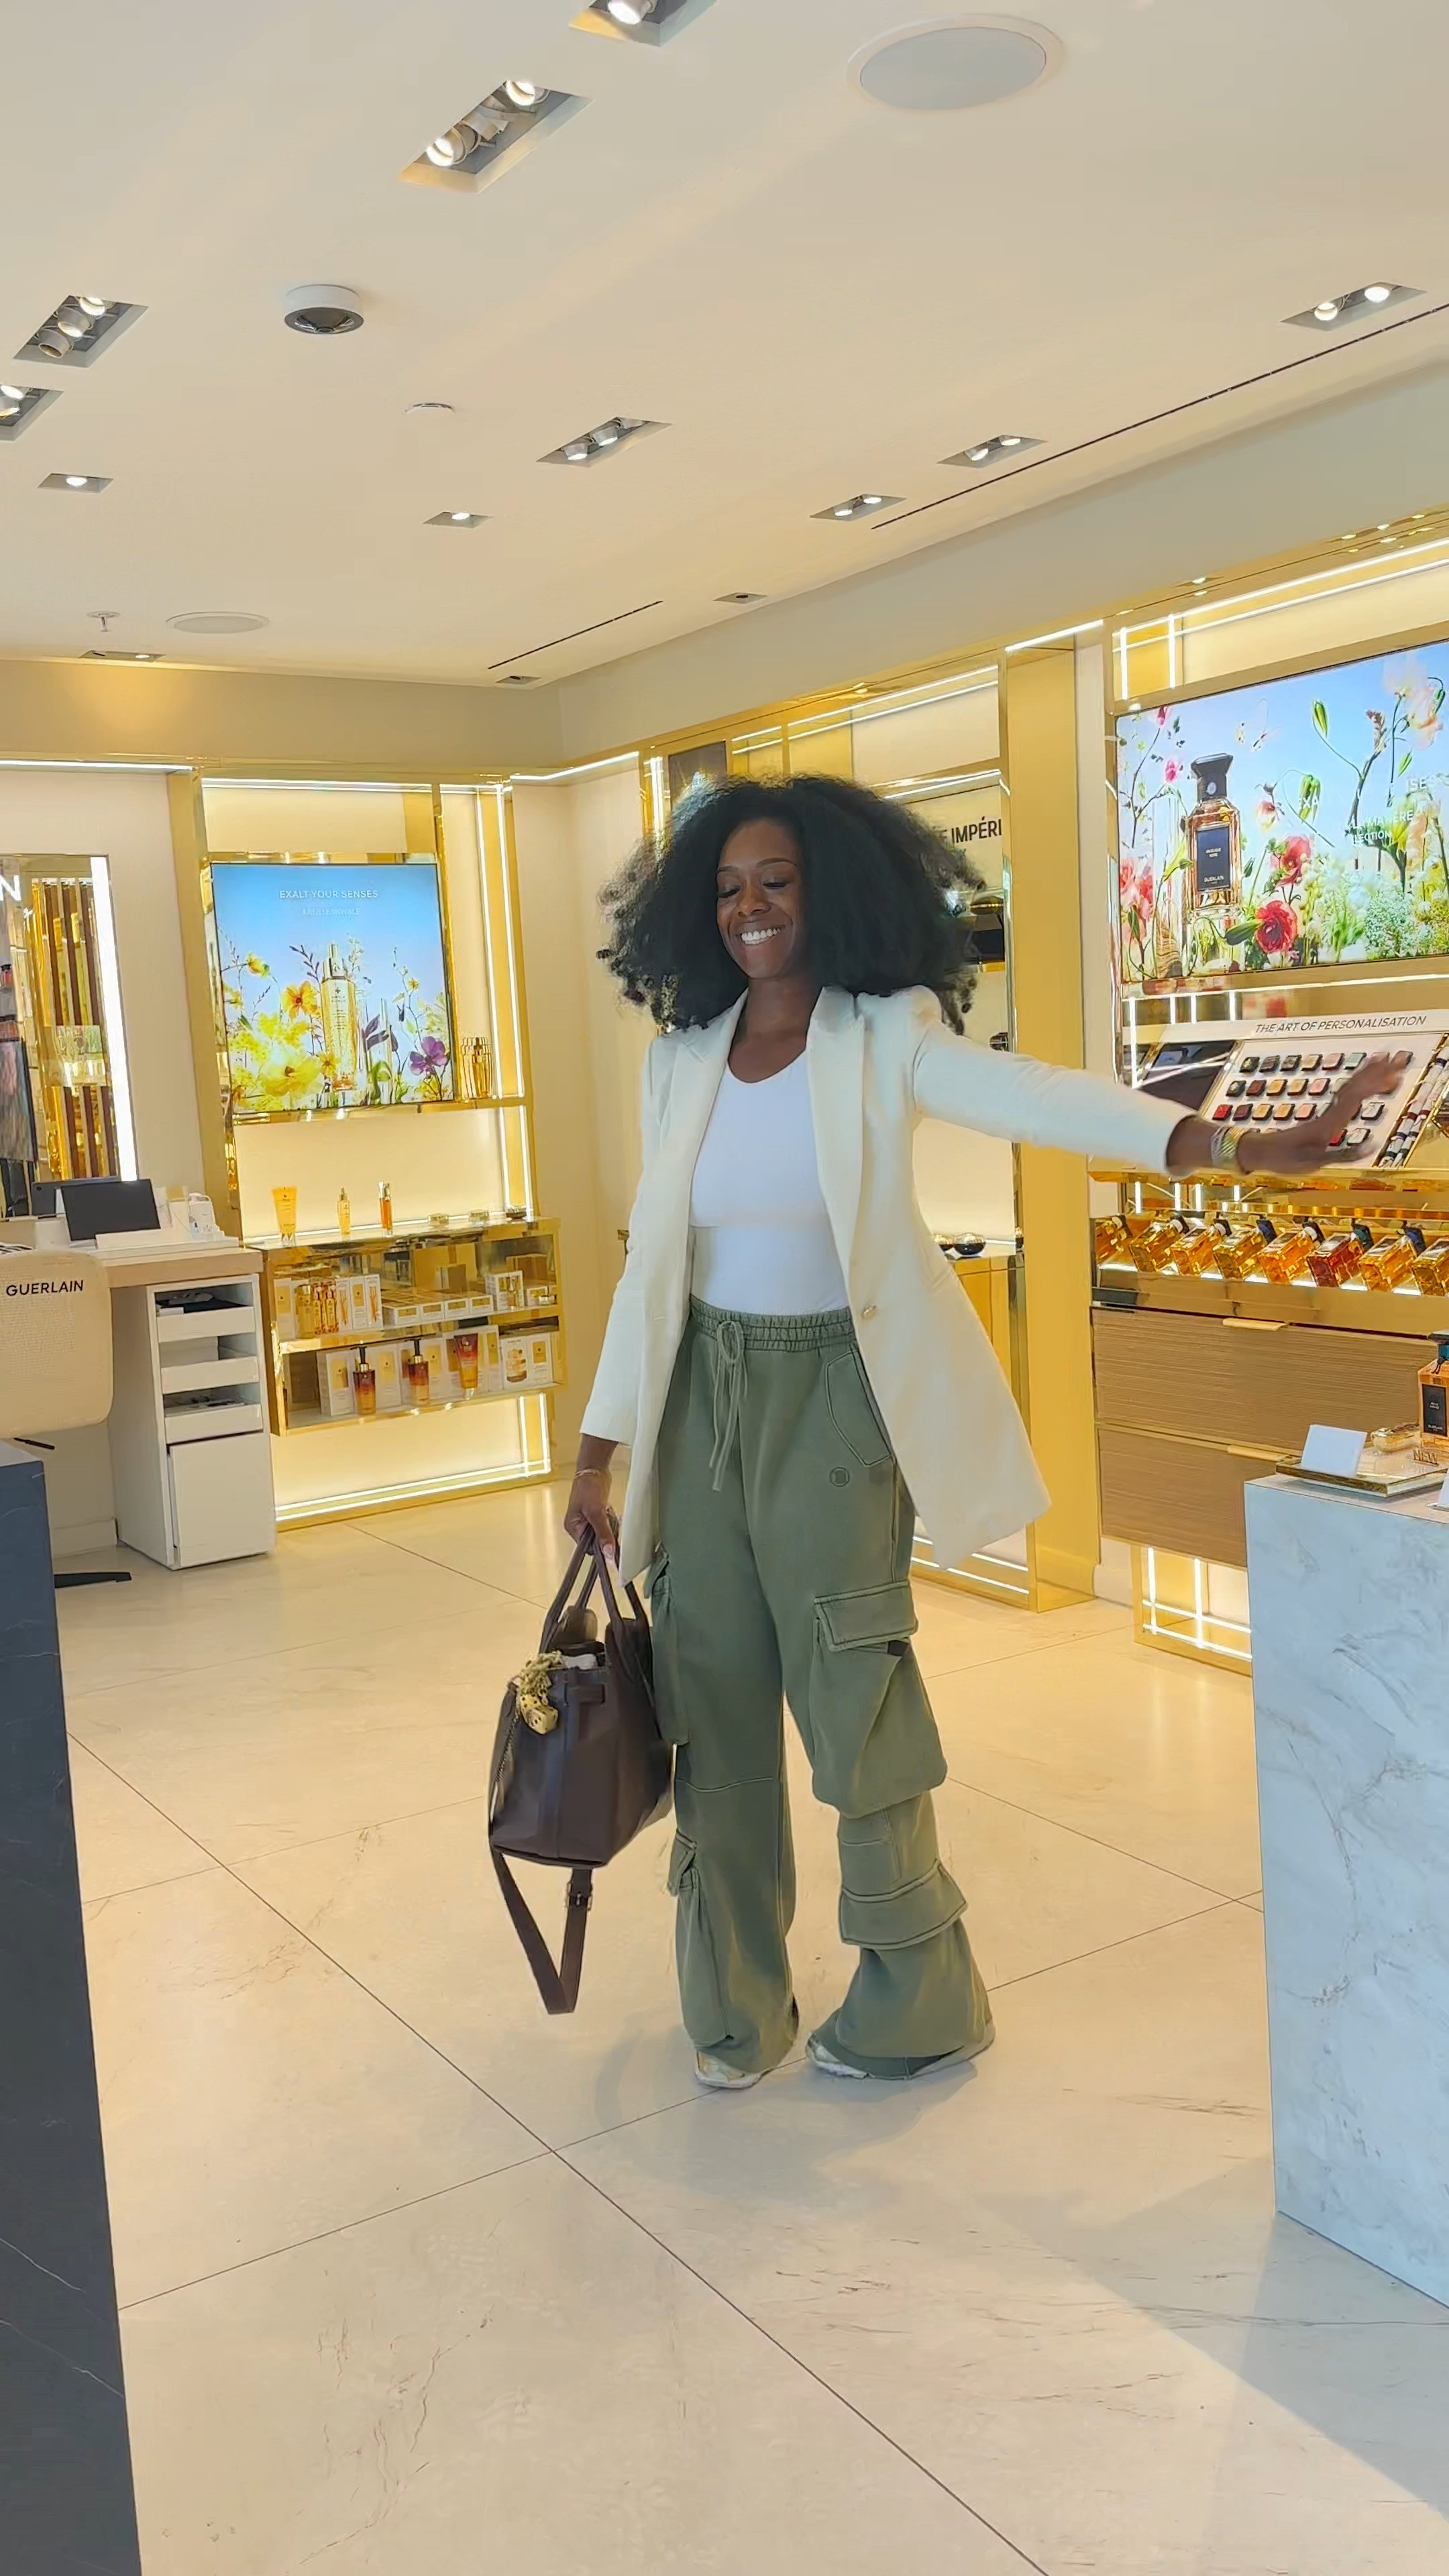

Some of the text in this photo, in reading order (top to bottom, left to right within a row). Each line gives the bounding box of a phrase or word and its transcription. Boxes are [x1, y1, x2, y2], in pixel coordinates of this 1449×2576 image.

[279, 889, 378, 899] EXALT YOUR SENSES
[1256, 1015, 1427, 1033] THE ART OF PERSONALISATION
[6, 1279, 83, 1296] GUERLAIN
